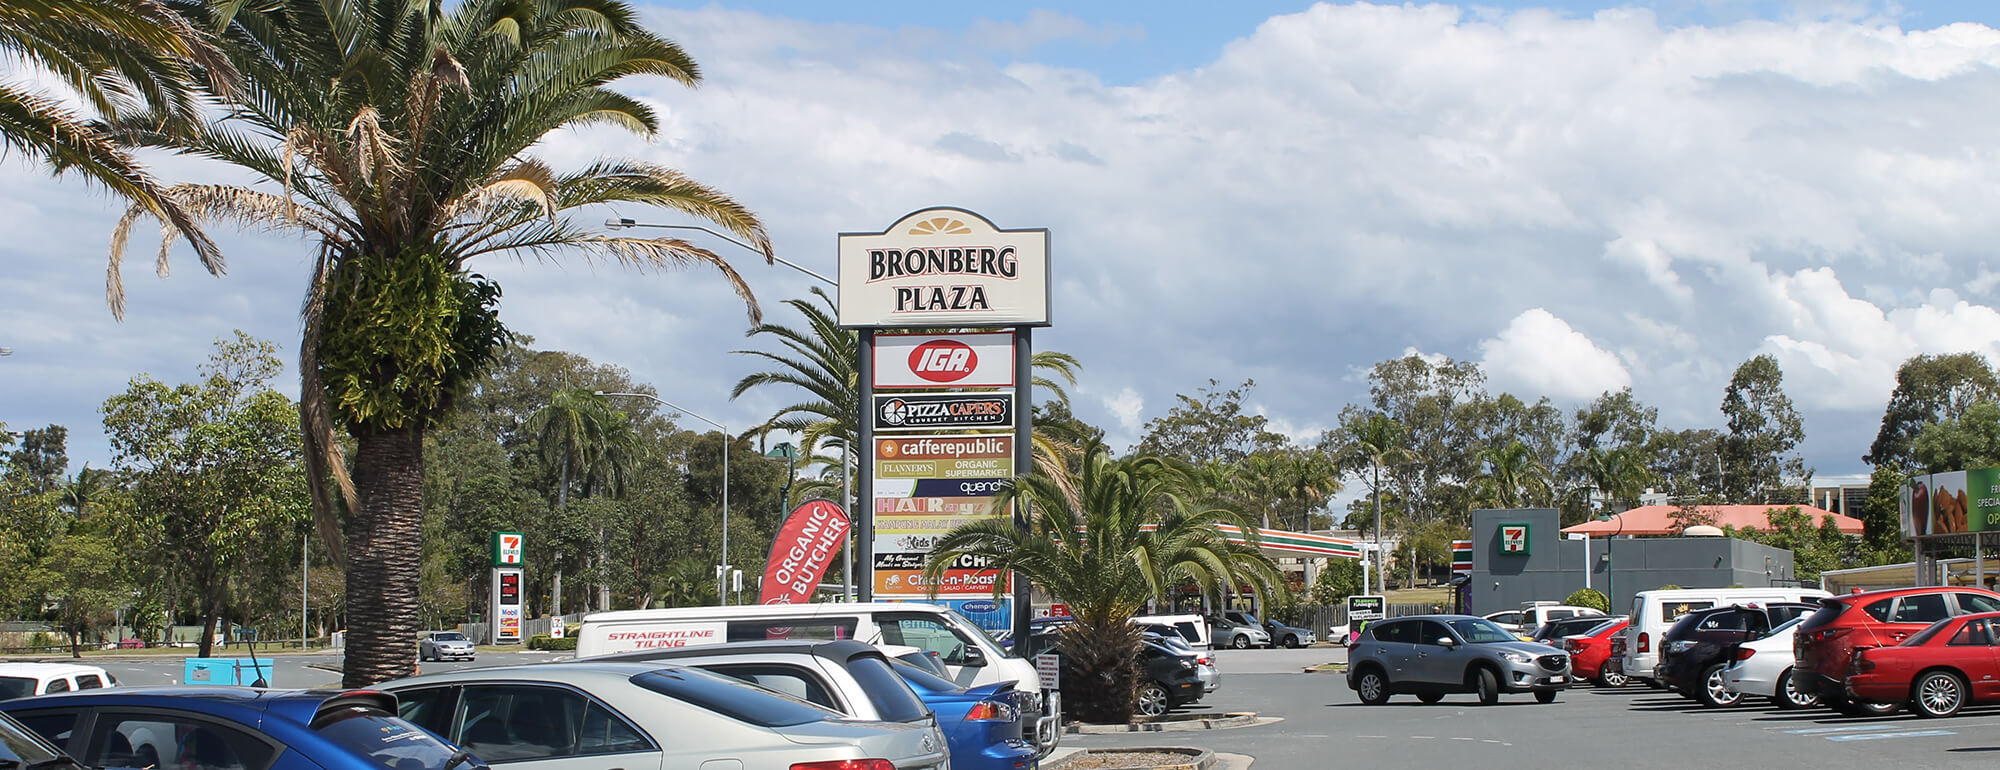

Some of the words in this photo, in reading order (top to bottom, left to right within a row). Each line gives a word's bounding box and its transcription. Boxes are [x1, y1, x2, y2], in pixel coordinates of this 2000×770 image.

[867, 246, 1018, 283] BRONBERG
[893, 286, 993, 312] PLAZA
[916, 348, 971, 372] IGA
[901, 438, 1004, 457] cafferepublic
[945, 469, 1008, 478] SUPERMARKET
[954, 460, 998, 469] ORGANIC
[776, 506, 828, 584] ORGANIC
[792, 517, 846, 595] BUTCHER
[607, 630, 715, 640] STRAIGHTLINE
